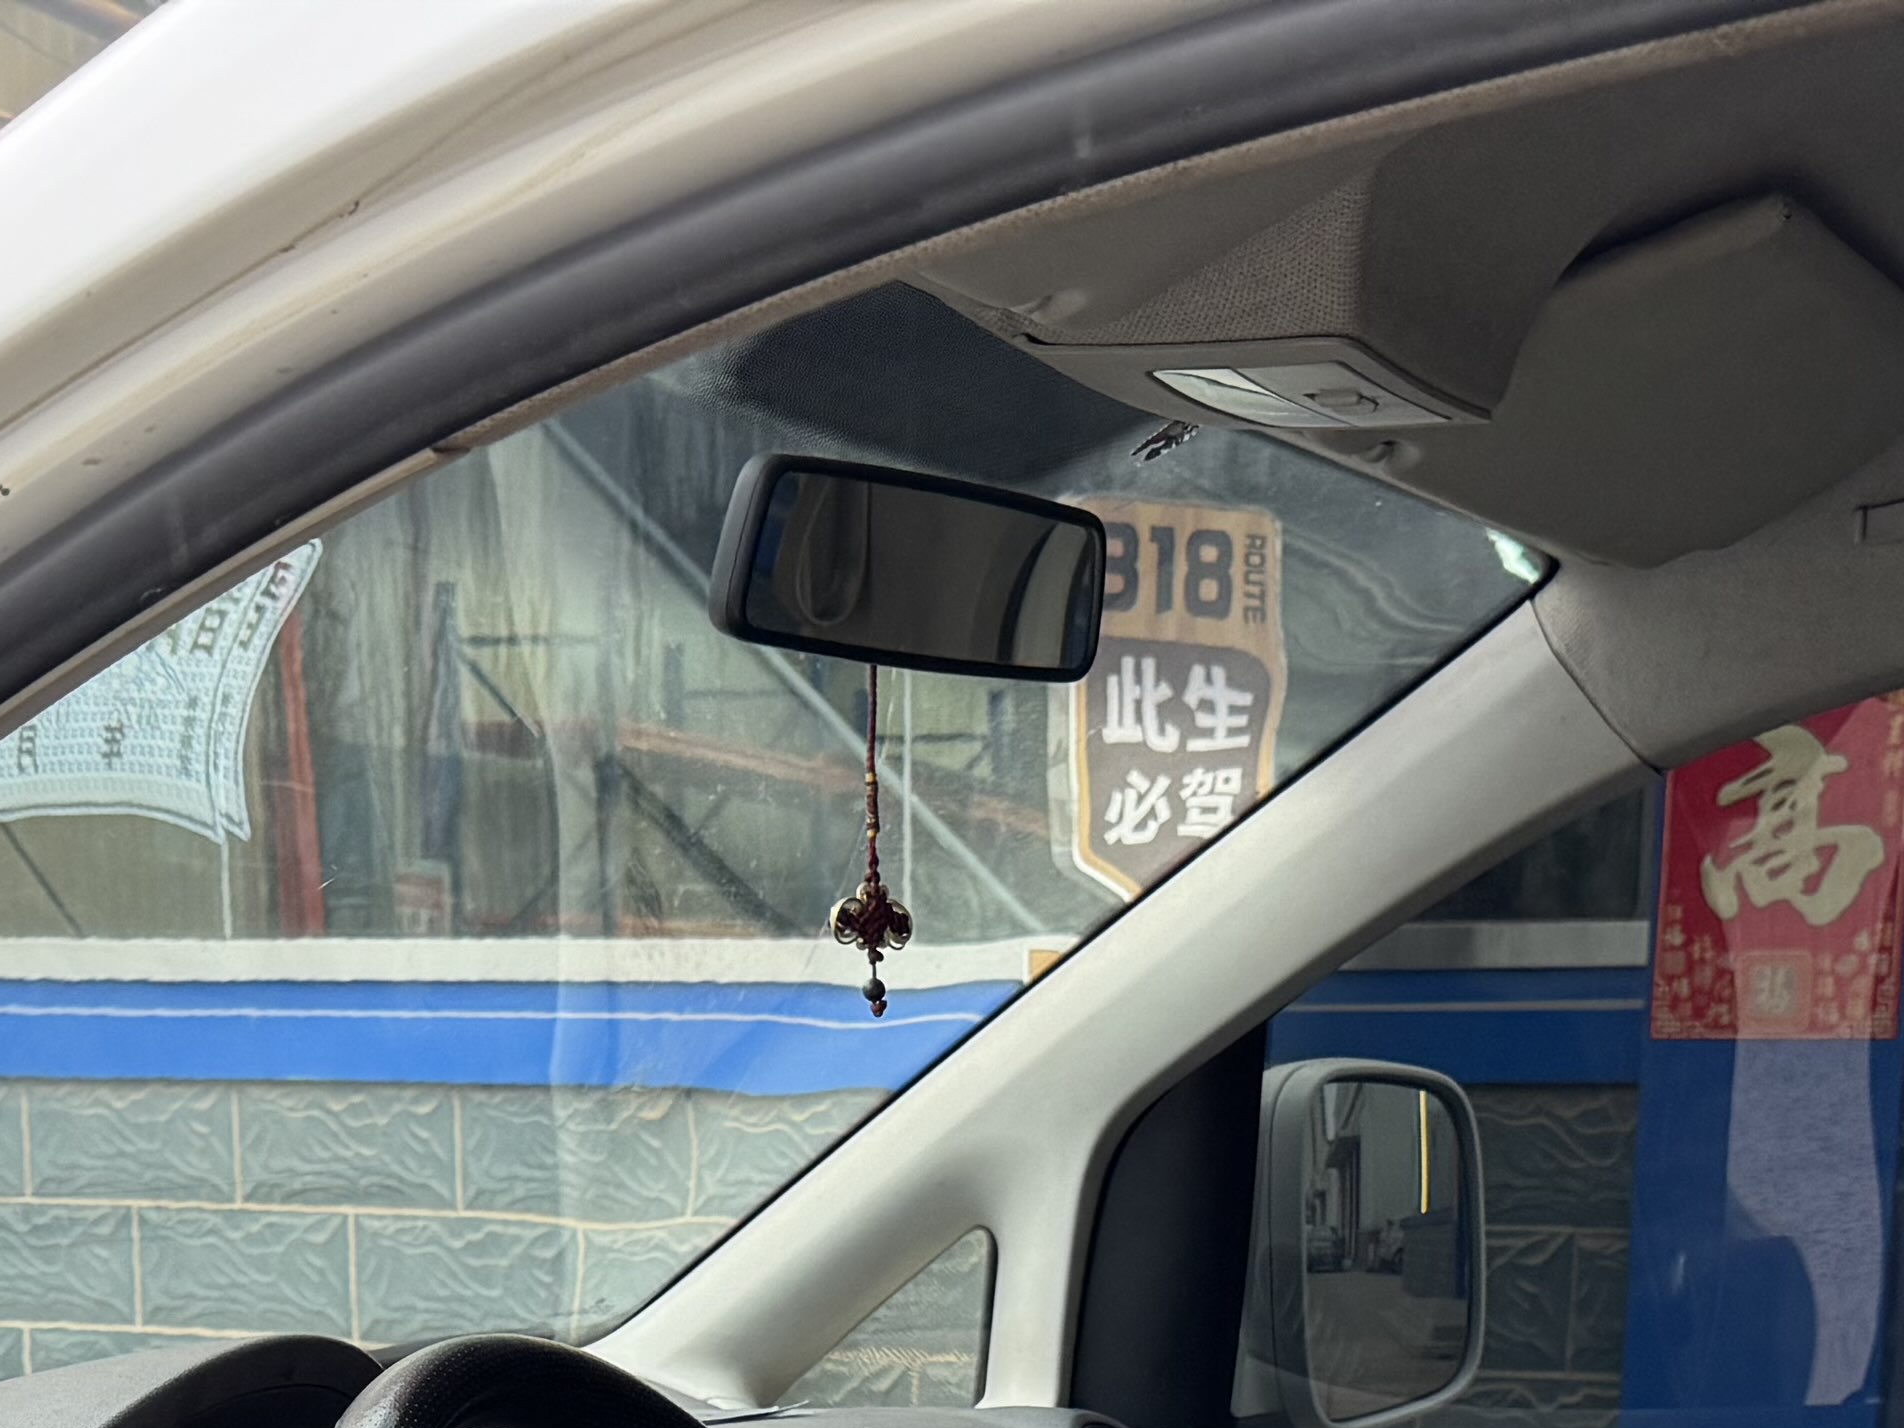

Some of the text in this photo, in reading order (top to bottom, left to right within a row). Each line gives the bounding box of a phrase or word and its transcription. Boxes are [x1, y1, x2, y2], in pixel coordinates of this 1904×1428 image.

[1243, 533, 1268, 624] ROUTE
[1102, 656, 1254, 753] 此生
[1103, 768, 1244, 845] 必驾
